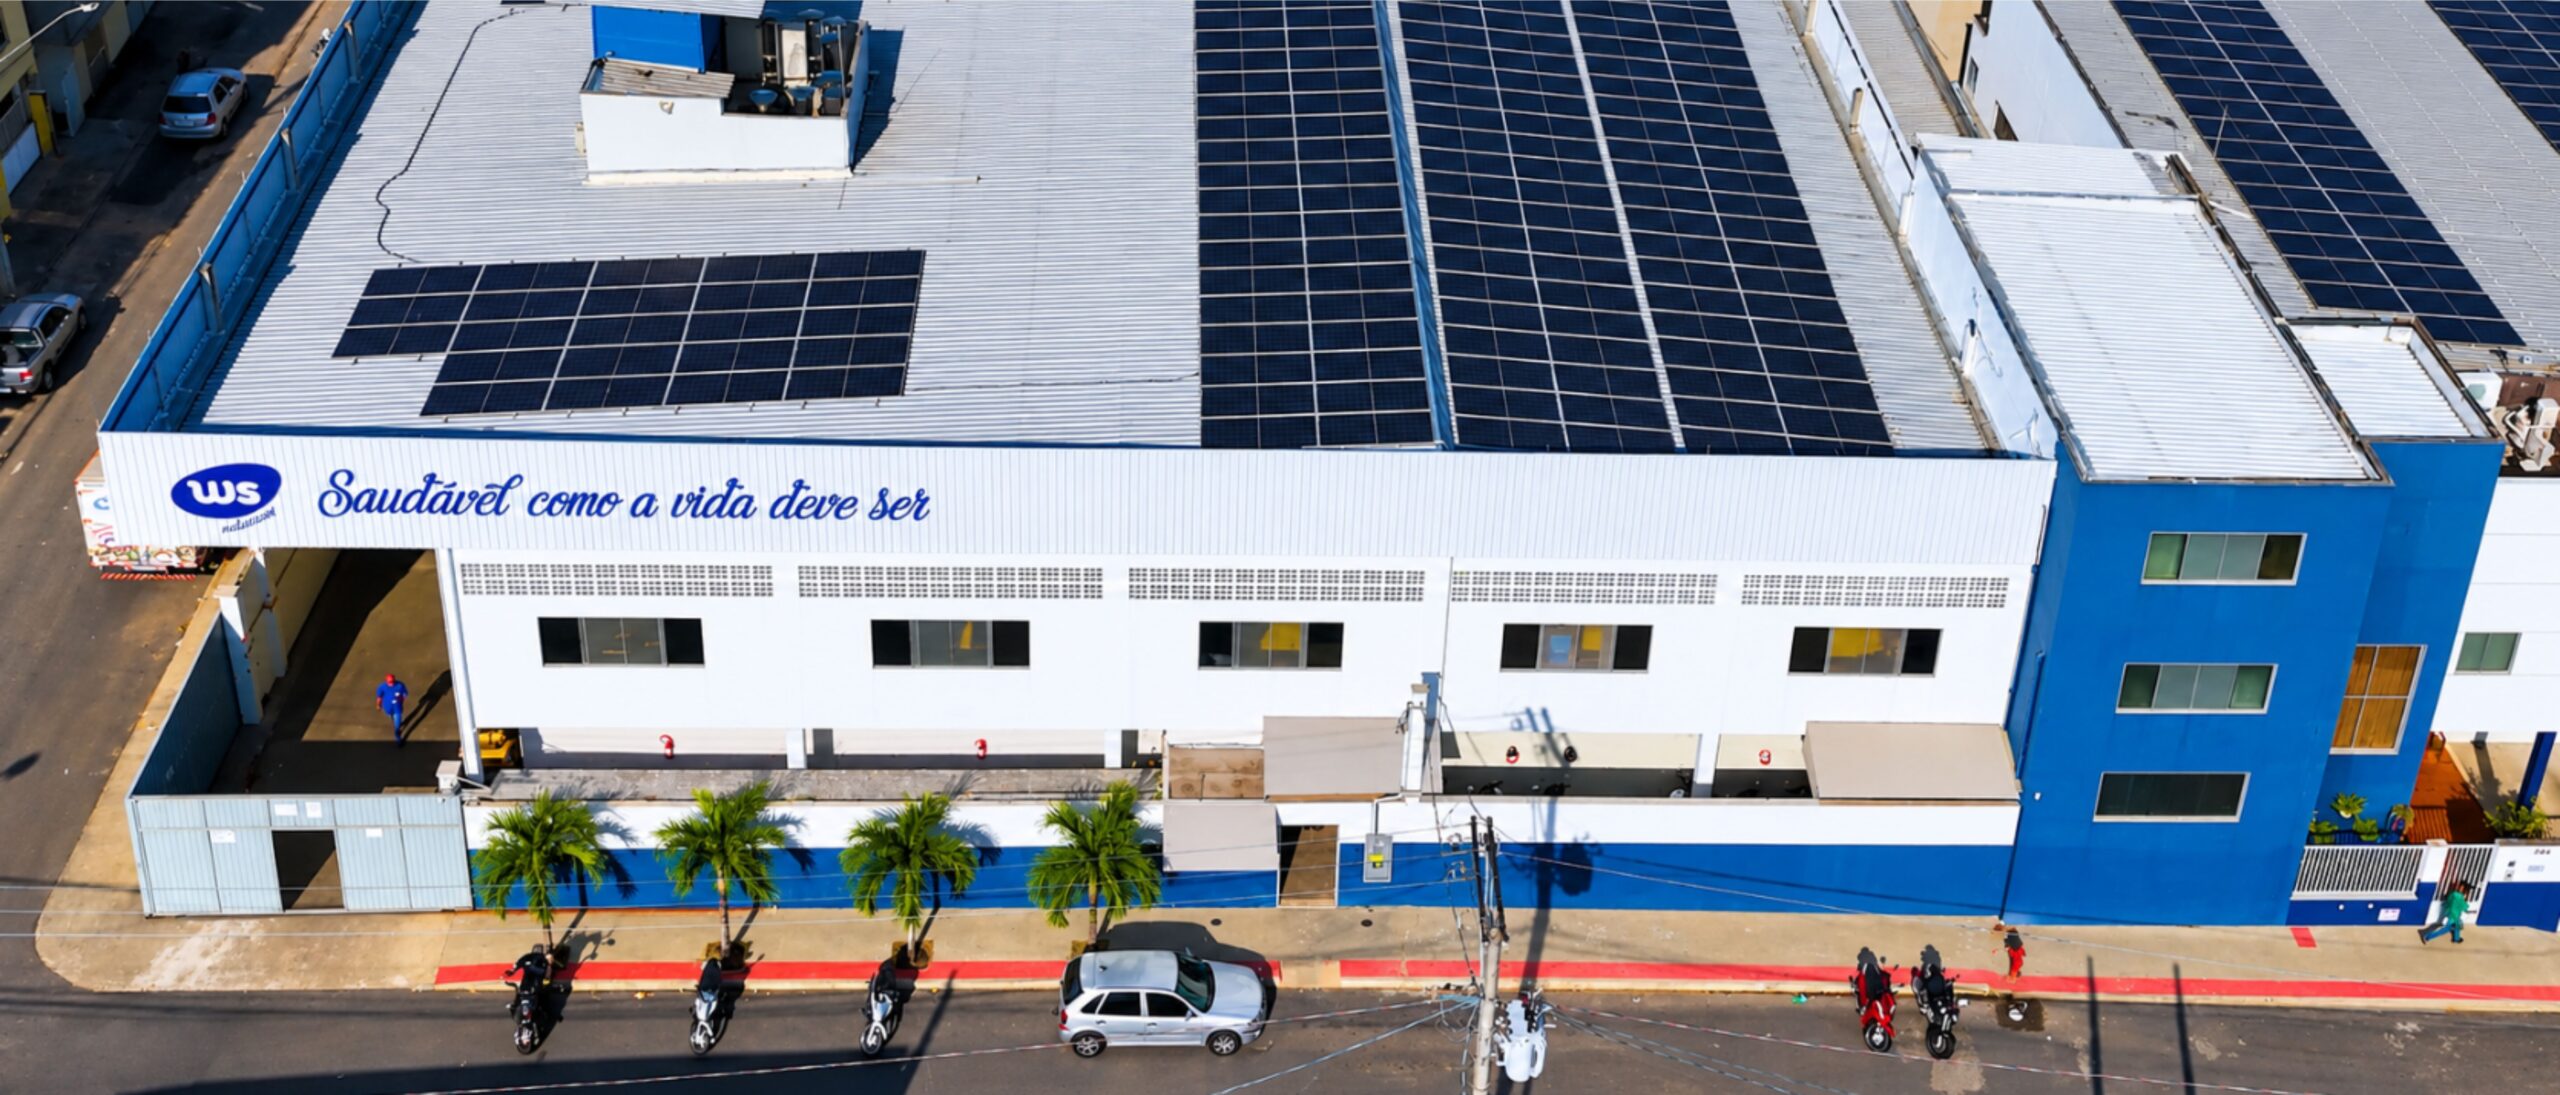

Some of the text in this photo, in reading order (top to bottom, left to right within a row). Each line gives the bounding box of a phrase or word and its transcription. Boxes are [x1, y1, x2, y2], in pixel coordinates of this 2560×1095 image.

[317, 468, 931, 521] Saudável como a vida deve ser
